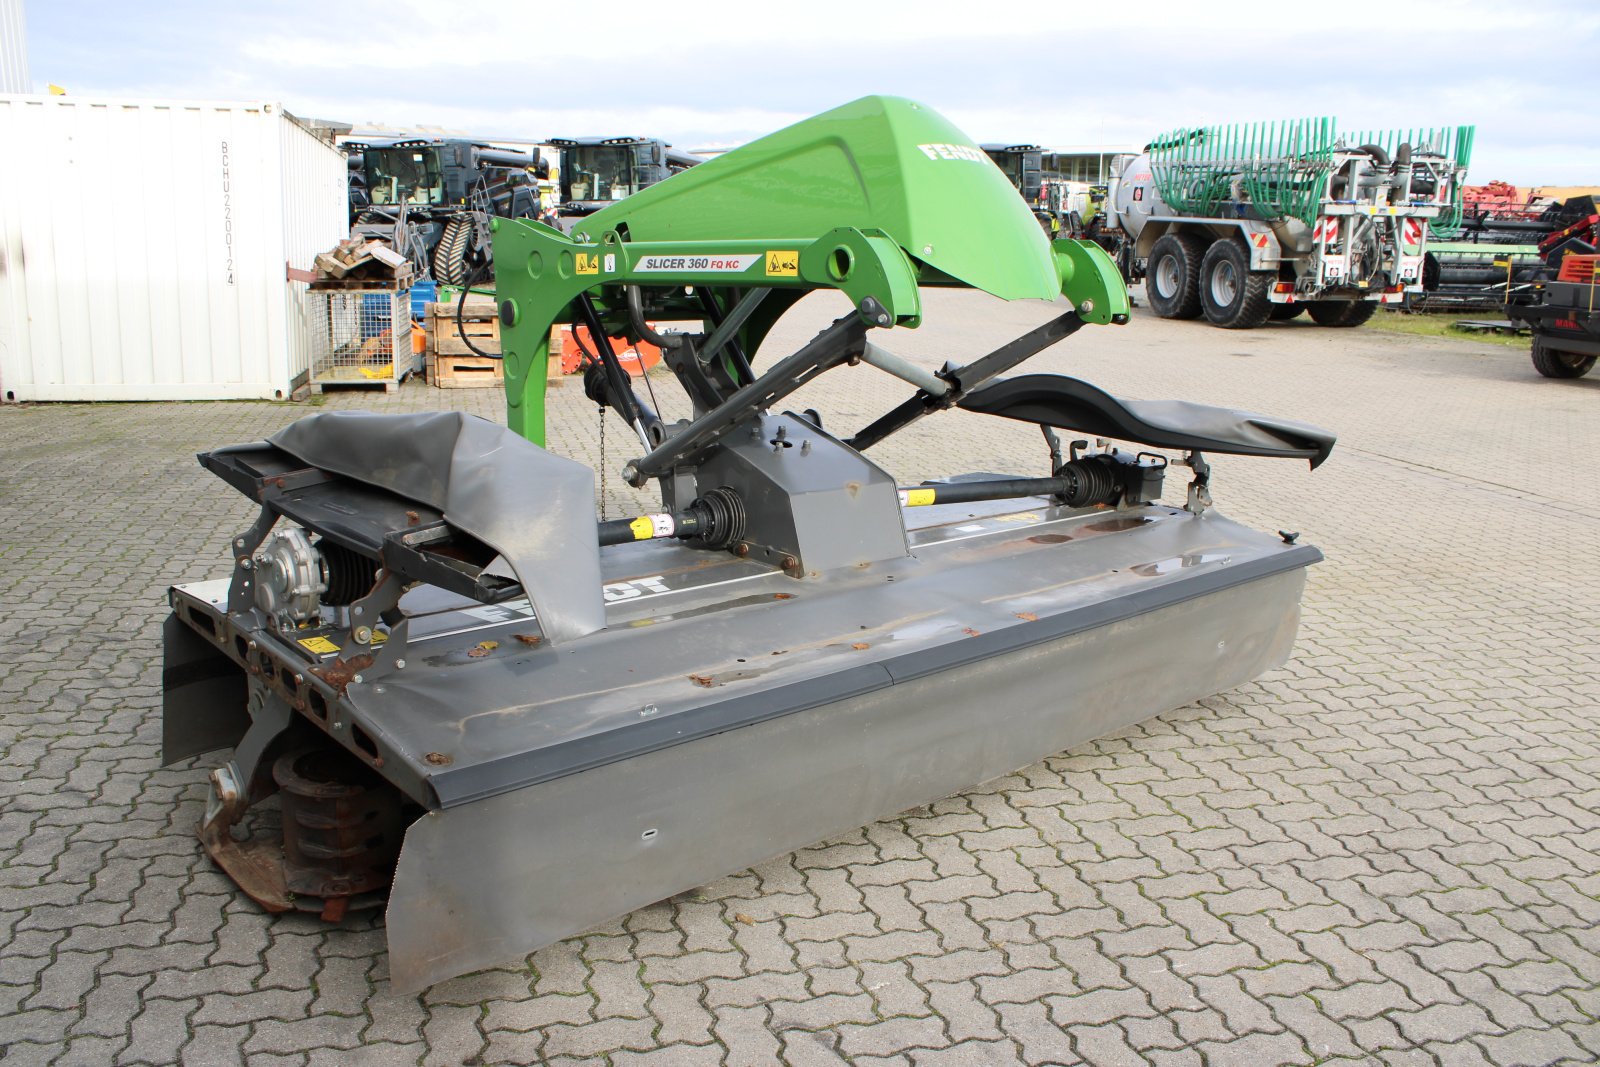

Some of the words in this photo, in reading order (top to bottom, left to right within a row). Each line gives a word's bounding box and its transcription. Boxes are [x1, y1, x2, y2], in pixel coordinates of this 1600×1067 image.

[917, 143, 988, 165] FENDT
[646, 258, 685, 269] SLICER
[687, 258, 708, 269] 360
[710, 260, 723, 269] FQ
[725, 260, 740, 269] KC
